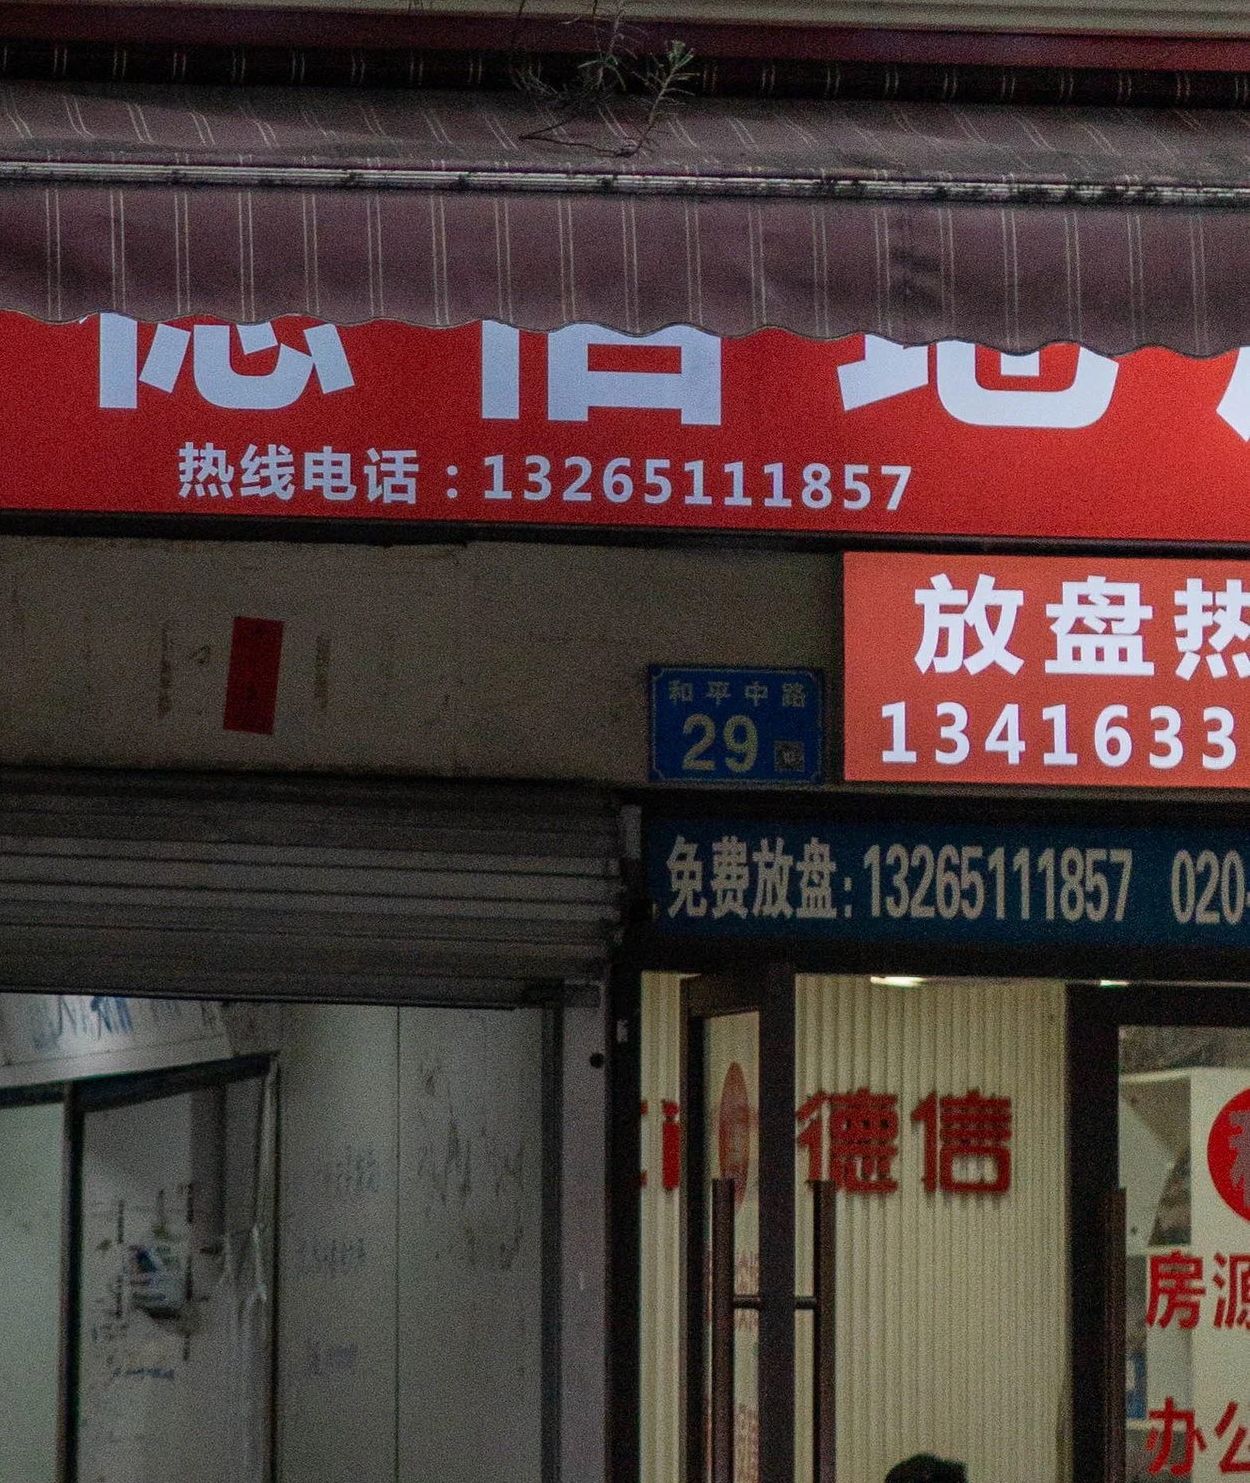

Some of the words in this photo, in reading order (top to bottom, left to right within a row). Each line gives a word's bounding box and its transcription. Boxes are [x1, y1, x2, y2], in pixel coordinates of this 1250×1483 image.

[667, 679, 807, 708] 和平中路
[681, 714, 759, 774] 29
[880, 700, 1238, 770] 1341633
